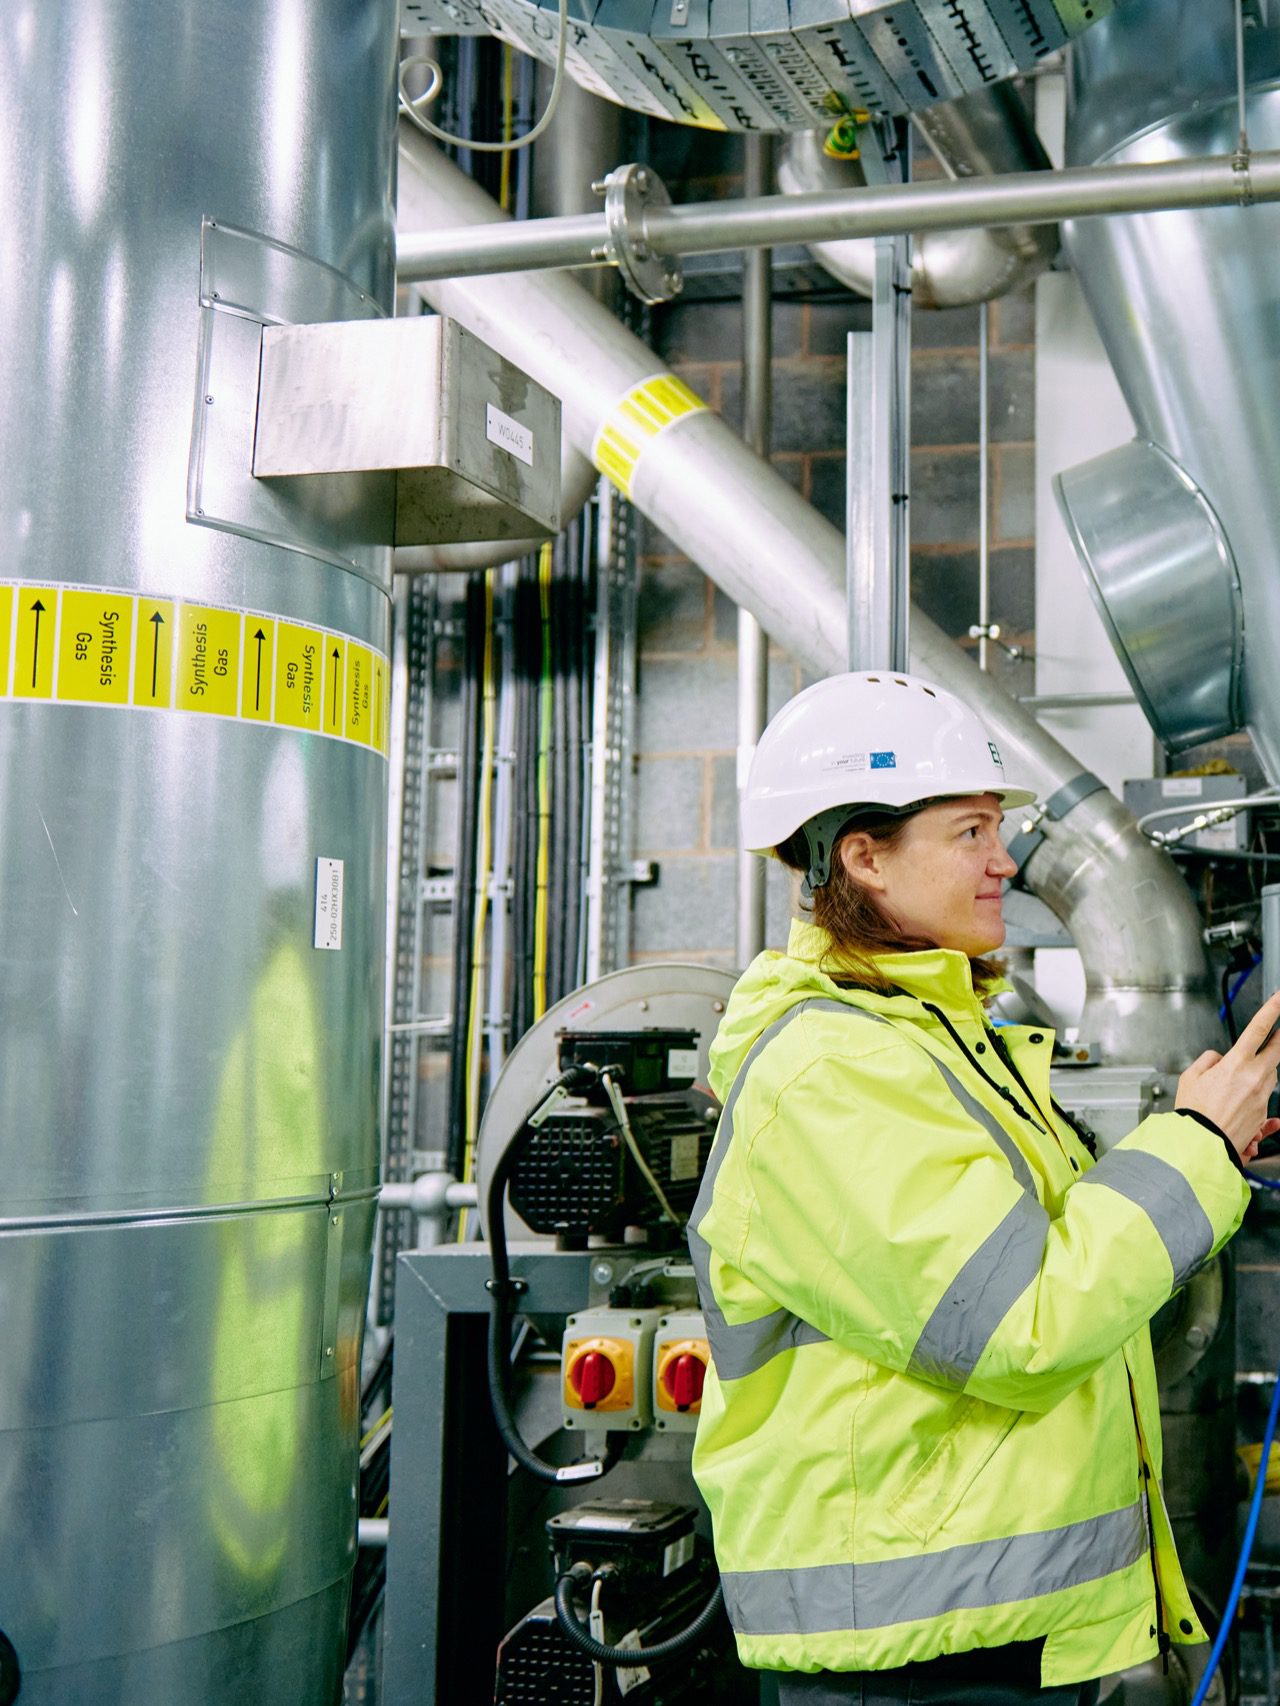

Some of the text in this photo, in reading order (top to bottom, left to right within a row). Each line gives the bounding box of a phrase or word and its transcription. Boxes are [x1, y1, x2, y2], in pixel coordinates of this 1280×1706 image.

[75, 632, 92, 661] Gas
[99, 611, 119, 686] Synthesis
[190, 623, 208, 696] Synthesis
[213, 648, 228, 676] Gas
[286, 662, 298, 689] Gas
[302, 645, 315, 714] Synthesis
[352, 660, 361, 726] Synthesis
[361, 684, 369, 709] Gas
